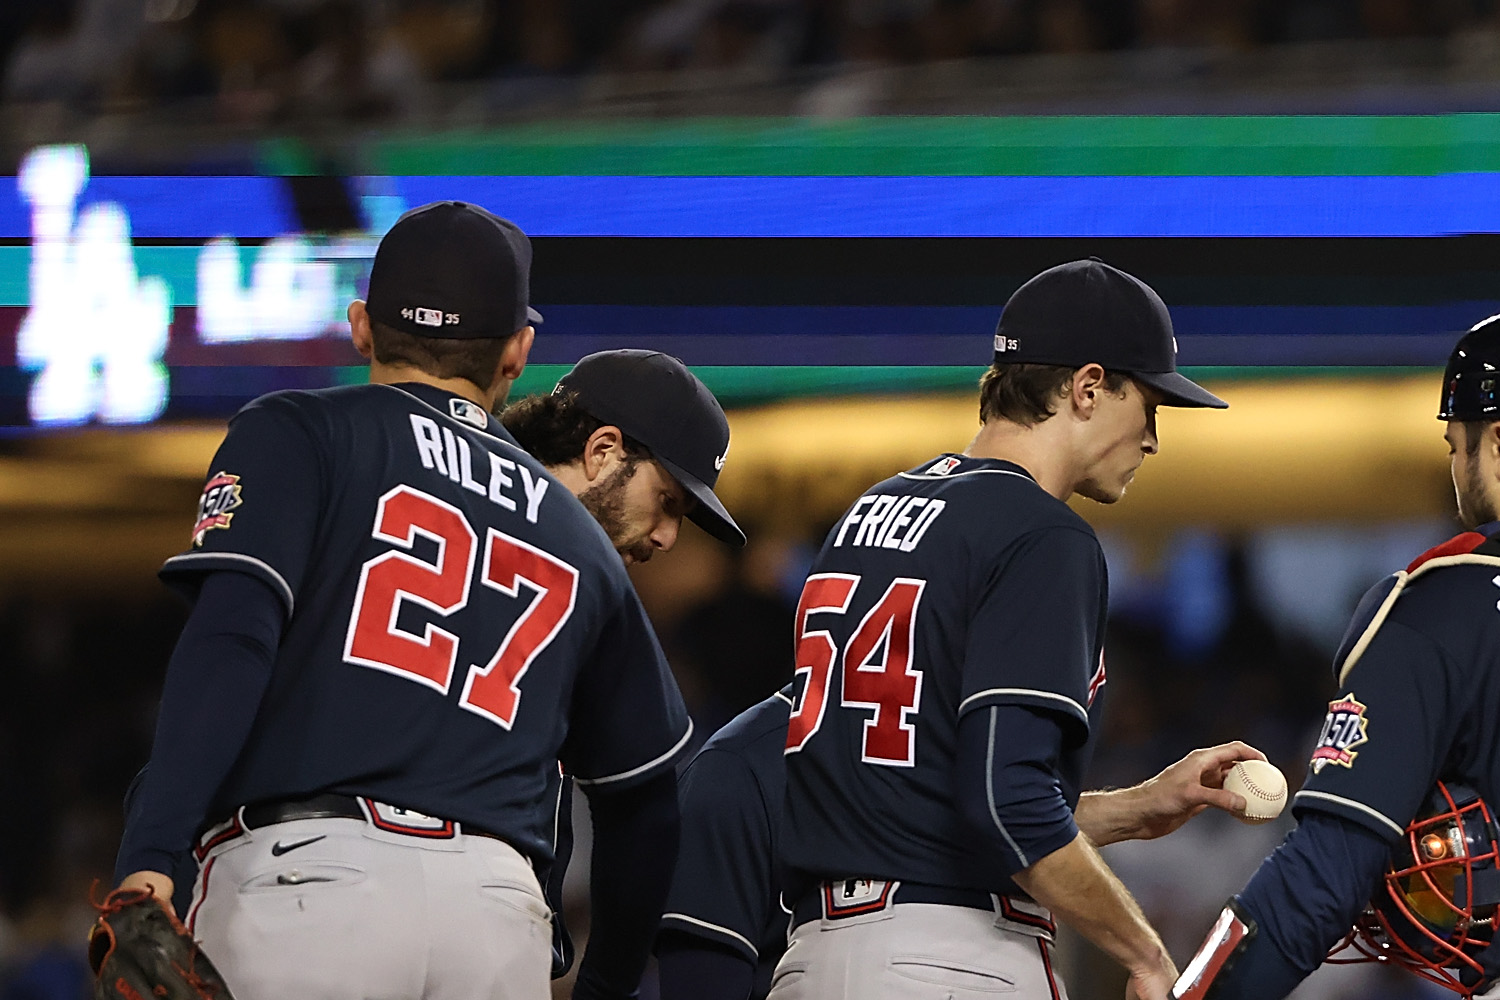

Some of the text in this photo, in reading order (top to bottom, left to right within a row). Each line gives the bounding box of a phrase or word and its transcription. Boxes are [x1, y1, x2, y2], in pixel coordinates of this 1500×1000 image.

[401, 307, 414, 320] 44
[445, 313, 460, 325] 35
[1007, 338, 1019, 350] 35
[410, 412, 550, 525] RILEY
[833, 494, 946, 552] FRIED
[341, 482, 580, 732] 27
[783, 571, 928, 768] 54
